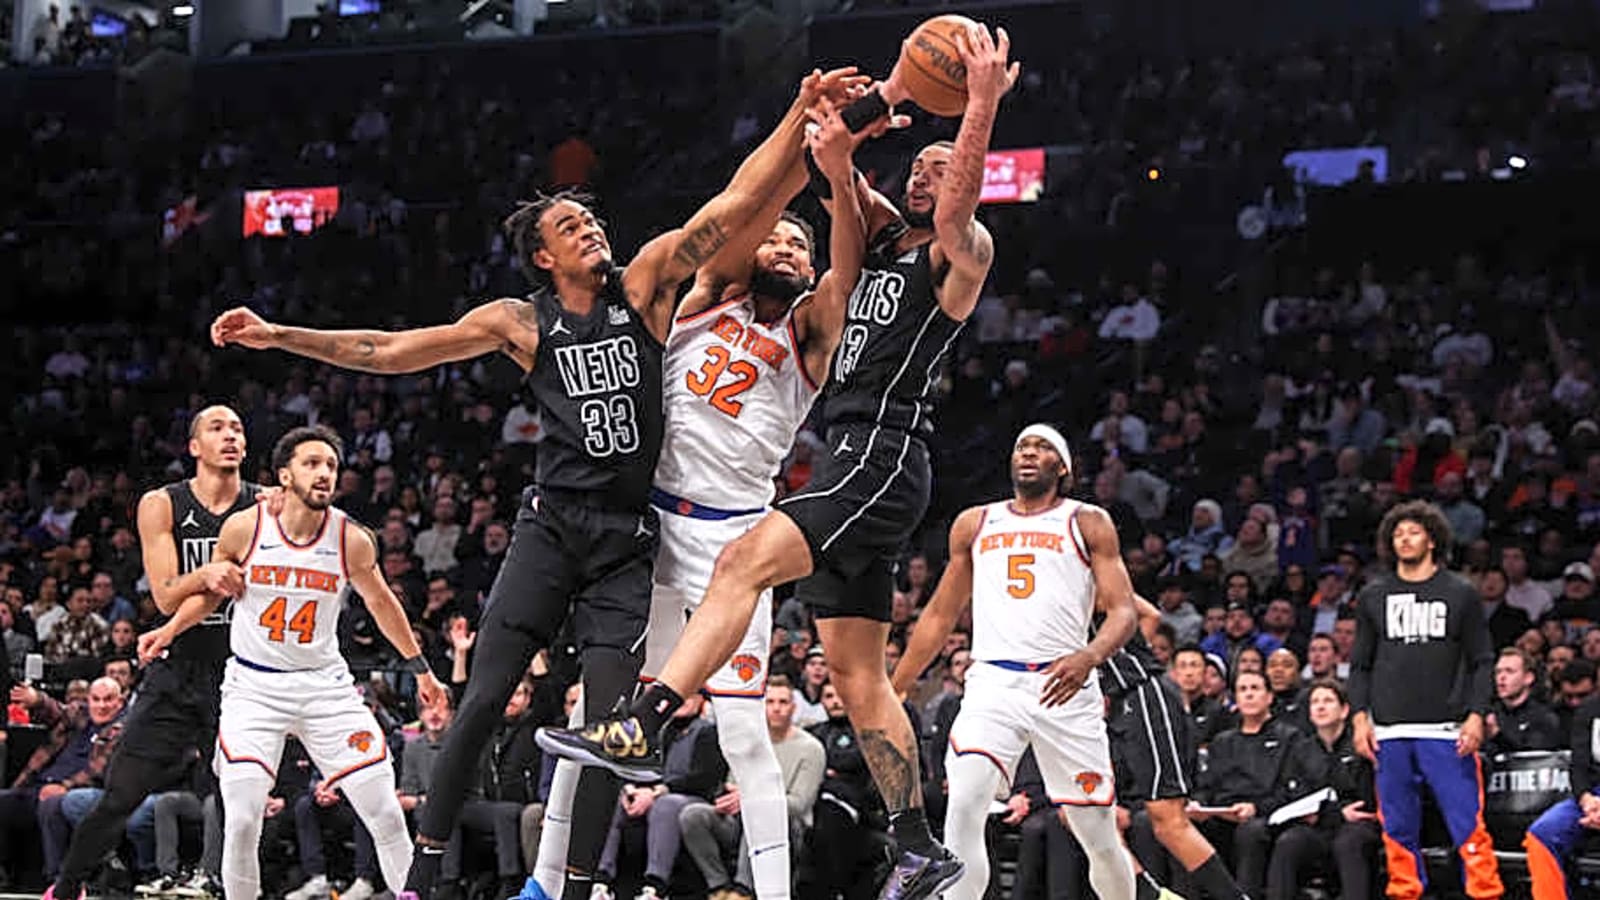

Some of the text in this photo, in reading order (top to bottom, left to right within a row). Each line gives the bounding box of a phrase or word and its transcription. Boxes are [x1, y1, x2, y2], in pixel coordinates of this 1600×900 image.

[554, 335, 640, 397] NETS
[686, 345, 759, 419] 32
[581, 394, 640, 458] 33
[980, 531, 1064, 554] NEW YORK
[250, 565, 340, 593] NEW YORK
[1007, 553, 1035, 599] 5
[259, 596, 318, 644] 44
[1387, 599, 1447, 638] KING
